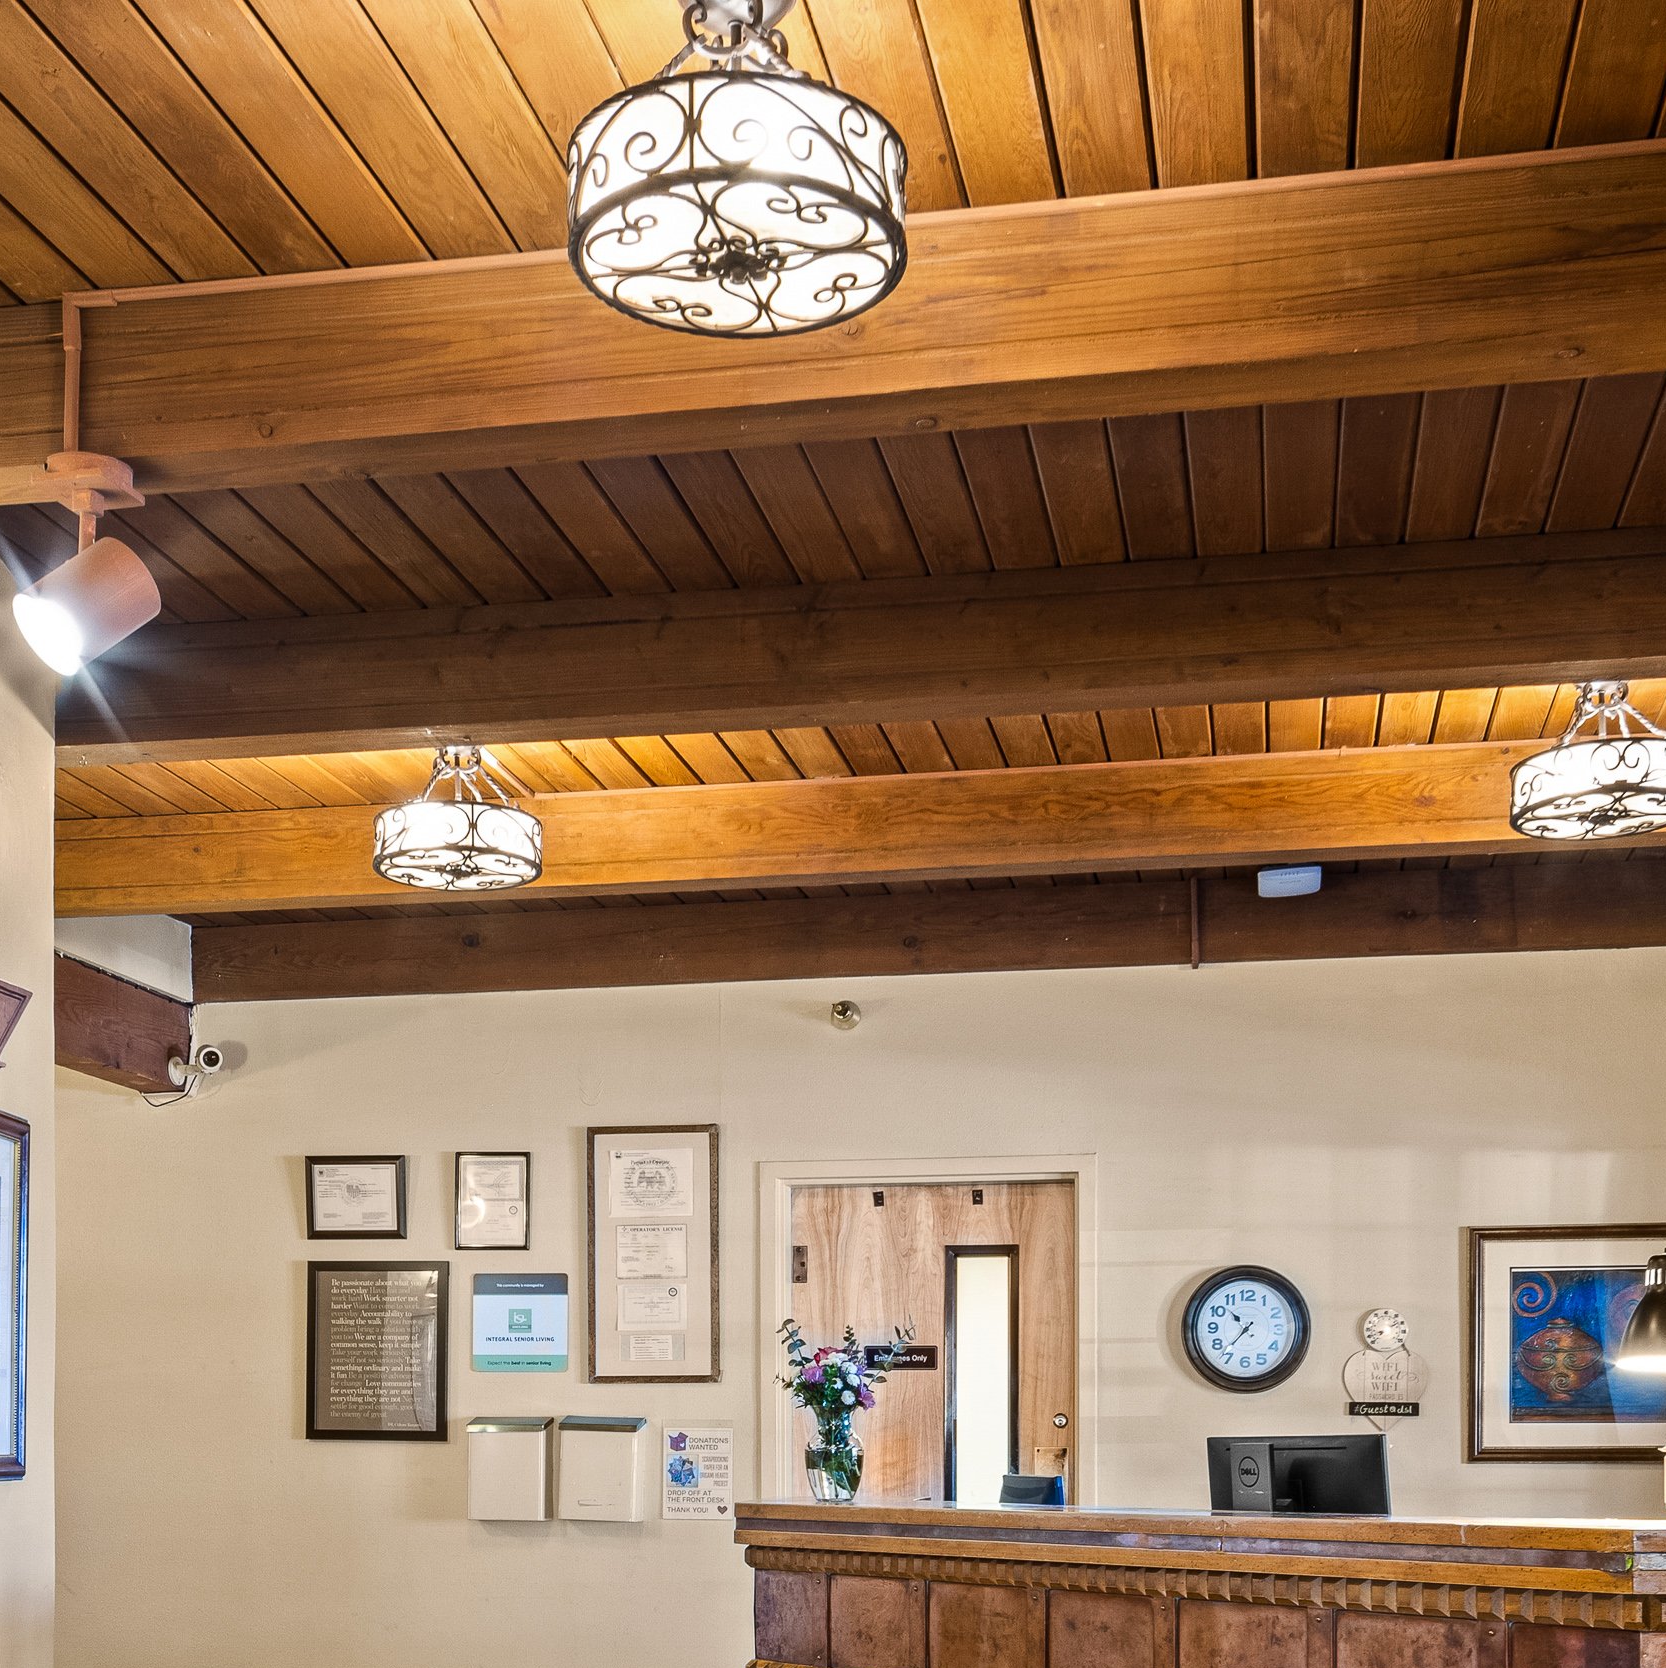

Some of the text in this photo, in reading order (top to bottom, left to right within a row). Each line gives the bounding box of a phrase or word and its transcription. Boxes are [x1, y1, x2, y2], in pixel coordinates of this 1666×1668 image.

[331, 1279, 422, 1287] Be passionate about what you
[1225, 1294, 1235, 1305] 11
[1239, 1289, 1256, 1301] 12
[1261, 1295, 1266, 1306] 1
[1210, 1306, 1225, 1317] 10
[1270, 1307, 1281, 1319] 2
[1208, 1322, 1218, 1333] 9
[1274, 1324, 1283, 1335] 3
[354, 1334, 365, 1342] We
[365, 1334, 376, 1342] are
[377, 1334, 381, 1342] a
[382, 1334, 410, 1342] company
[412, 1334, 419, 1342] of
[1212, 1339, 1222, 1350] 8
[1268, 1340, 1278, 1351] 4
[911, 1354, 927, 1363] Only
[1223, 1353, 1233, 1364] 7
[1240, 1357, 1250, 1368] 6
[1256, 1354, 1267, 1365] 5
[330, 1364, 422, 1372] something ordinary and make
[1372, 1362, 1397, 1371] WIFI
[1372, 1382, 1397, 1391] WIFI
[330, 1395, 401, 1403] everything they are not
[1241, 1468, 1257, 1476] DELL
